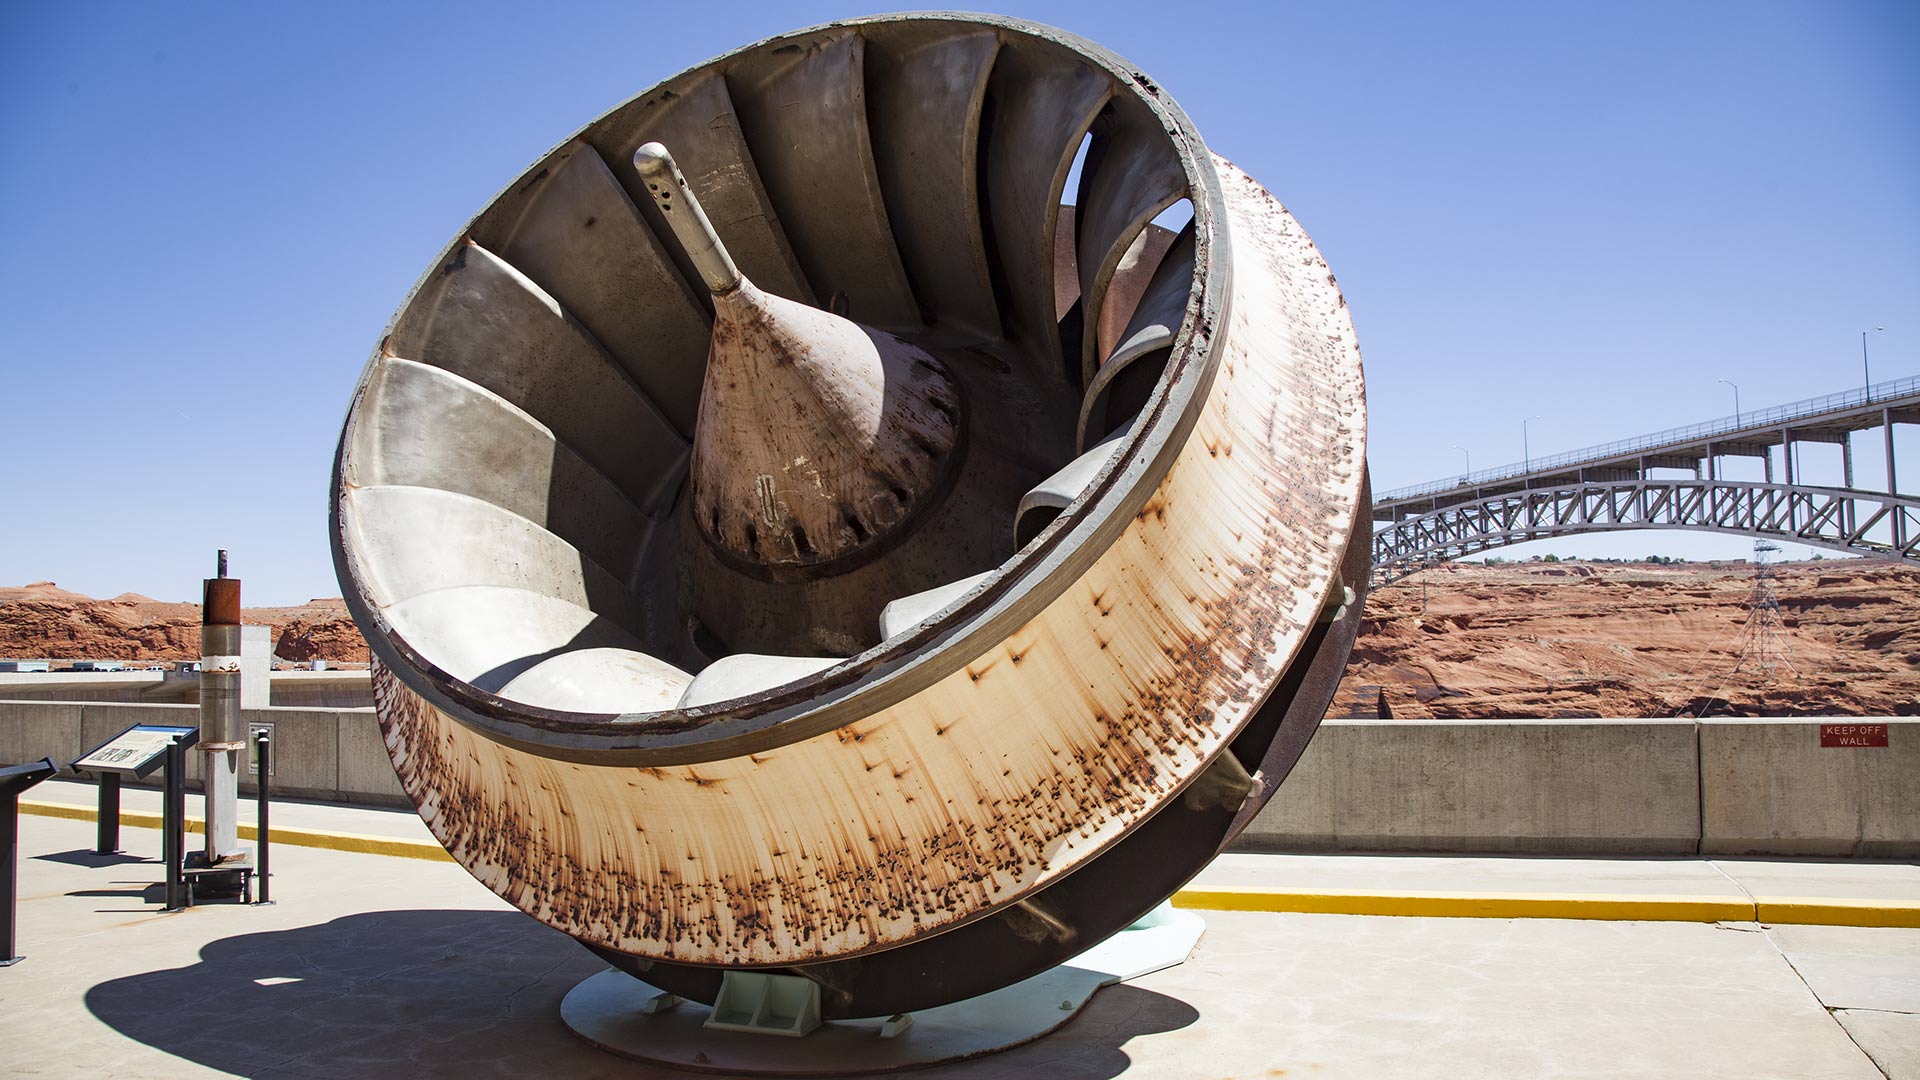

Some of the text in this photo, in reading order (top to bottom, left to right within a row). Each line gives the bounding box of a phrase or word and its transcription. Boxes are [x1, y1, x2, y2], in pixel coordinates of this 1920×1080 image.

[1826, 726, 1881, 735] KEEP OFF
[1839, 737, 1869, 746] WALL
